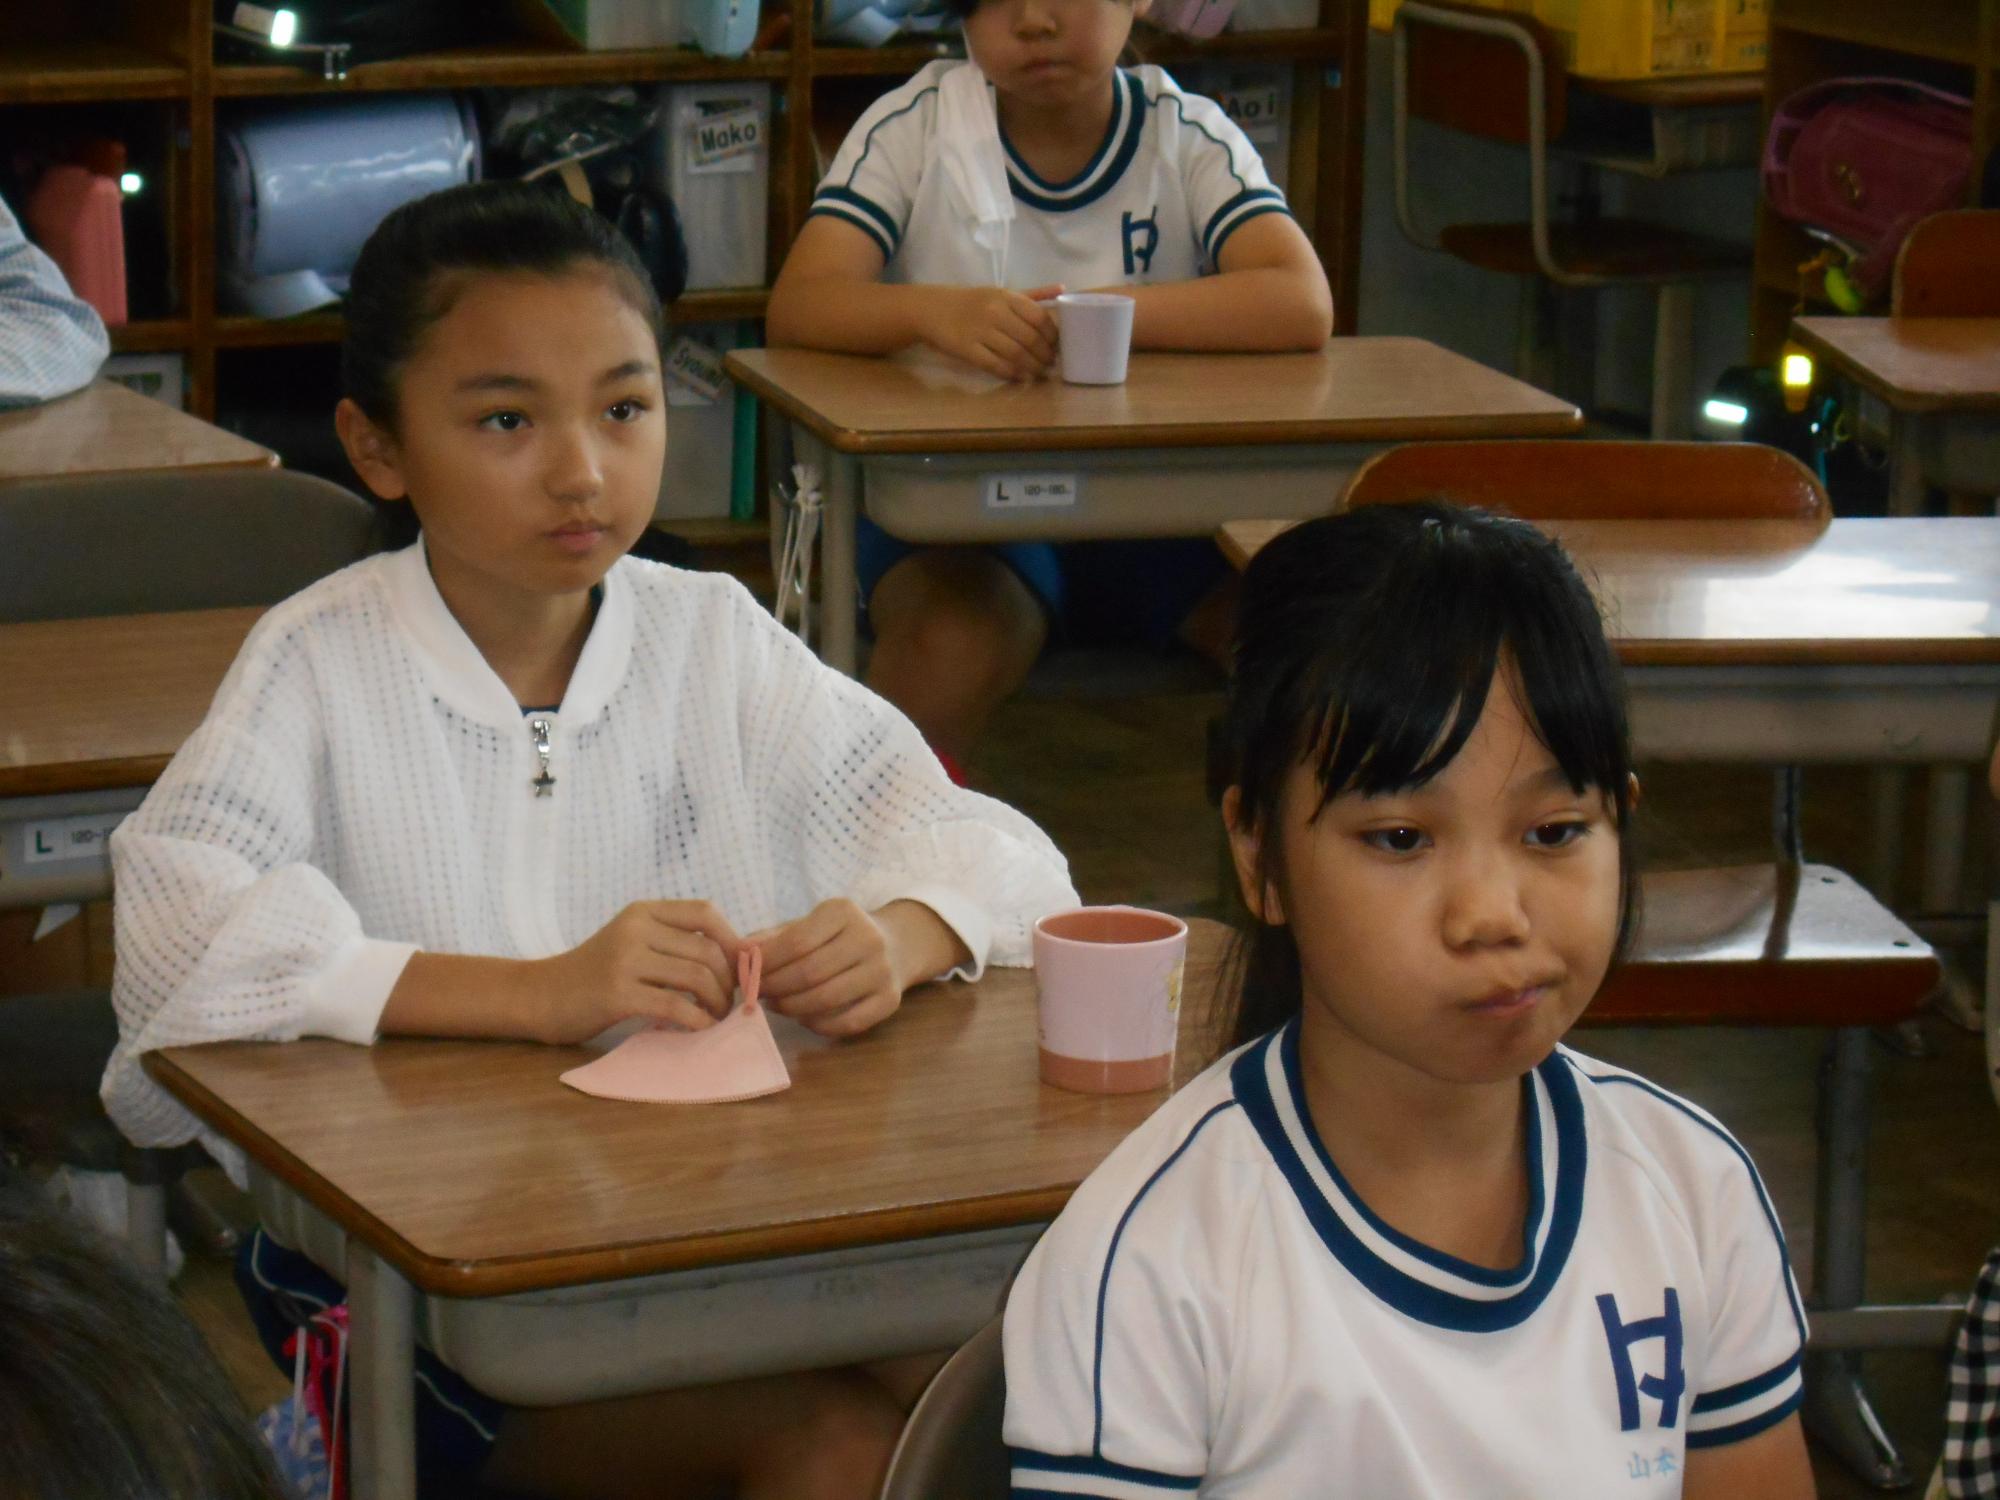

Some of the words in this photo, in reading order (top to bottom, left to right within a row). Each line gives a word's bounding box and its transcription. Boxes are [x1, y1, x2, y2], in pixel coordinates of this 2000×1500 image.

[1227, 92, 1275, 118] Aoi
[701, 122, 757, 153] Mako
[996, 480, 1010, 501] L
[36, 830, 53, 854] L
[1627, 1447, 1678, 1479] 山本
